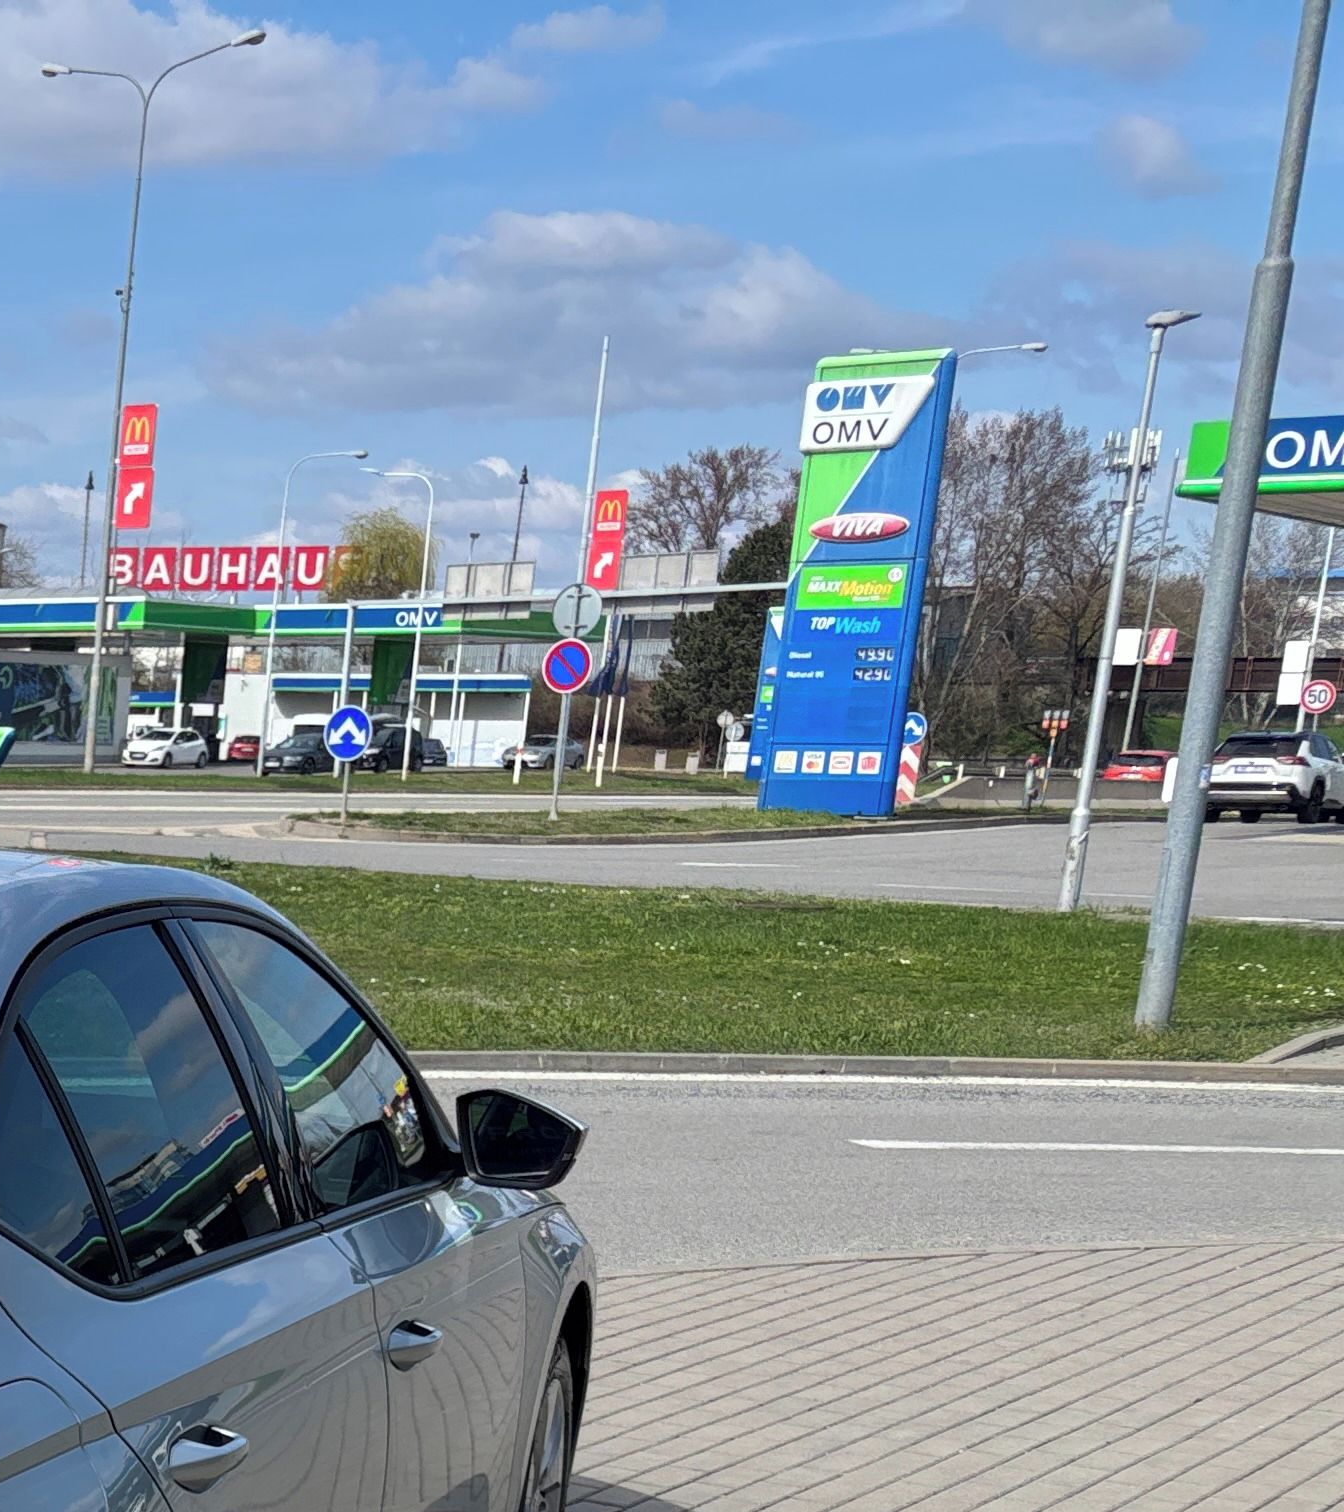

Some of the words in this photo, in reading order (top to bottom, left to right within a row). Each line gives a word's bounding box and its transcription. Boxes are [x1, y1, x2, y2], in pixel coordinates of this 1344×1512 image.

[812, 418, 889, 444] OMV
[831, 518, 886, 537] VIVA
[395, 611, 438, 627] OMV
[1308, 689, 1328, 704] 50
